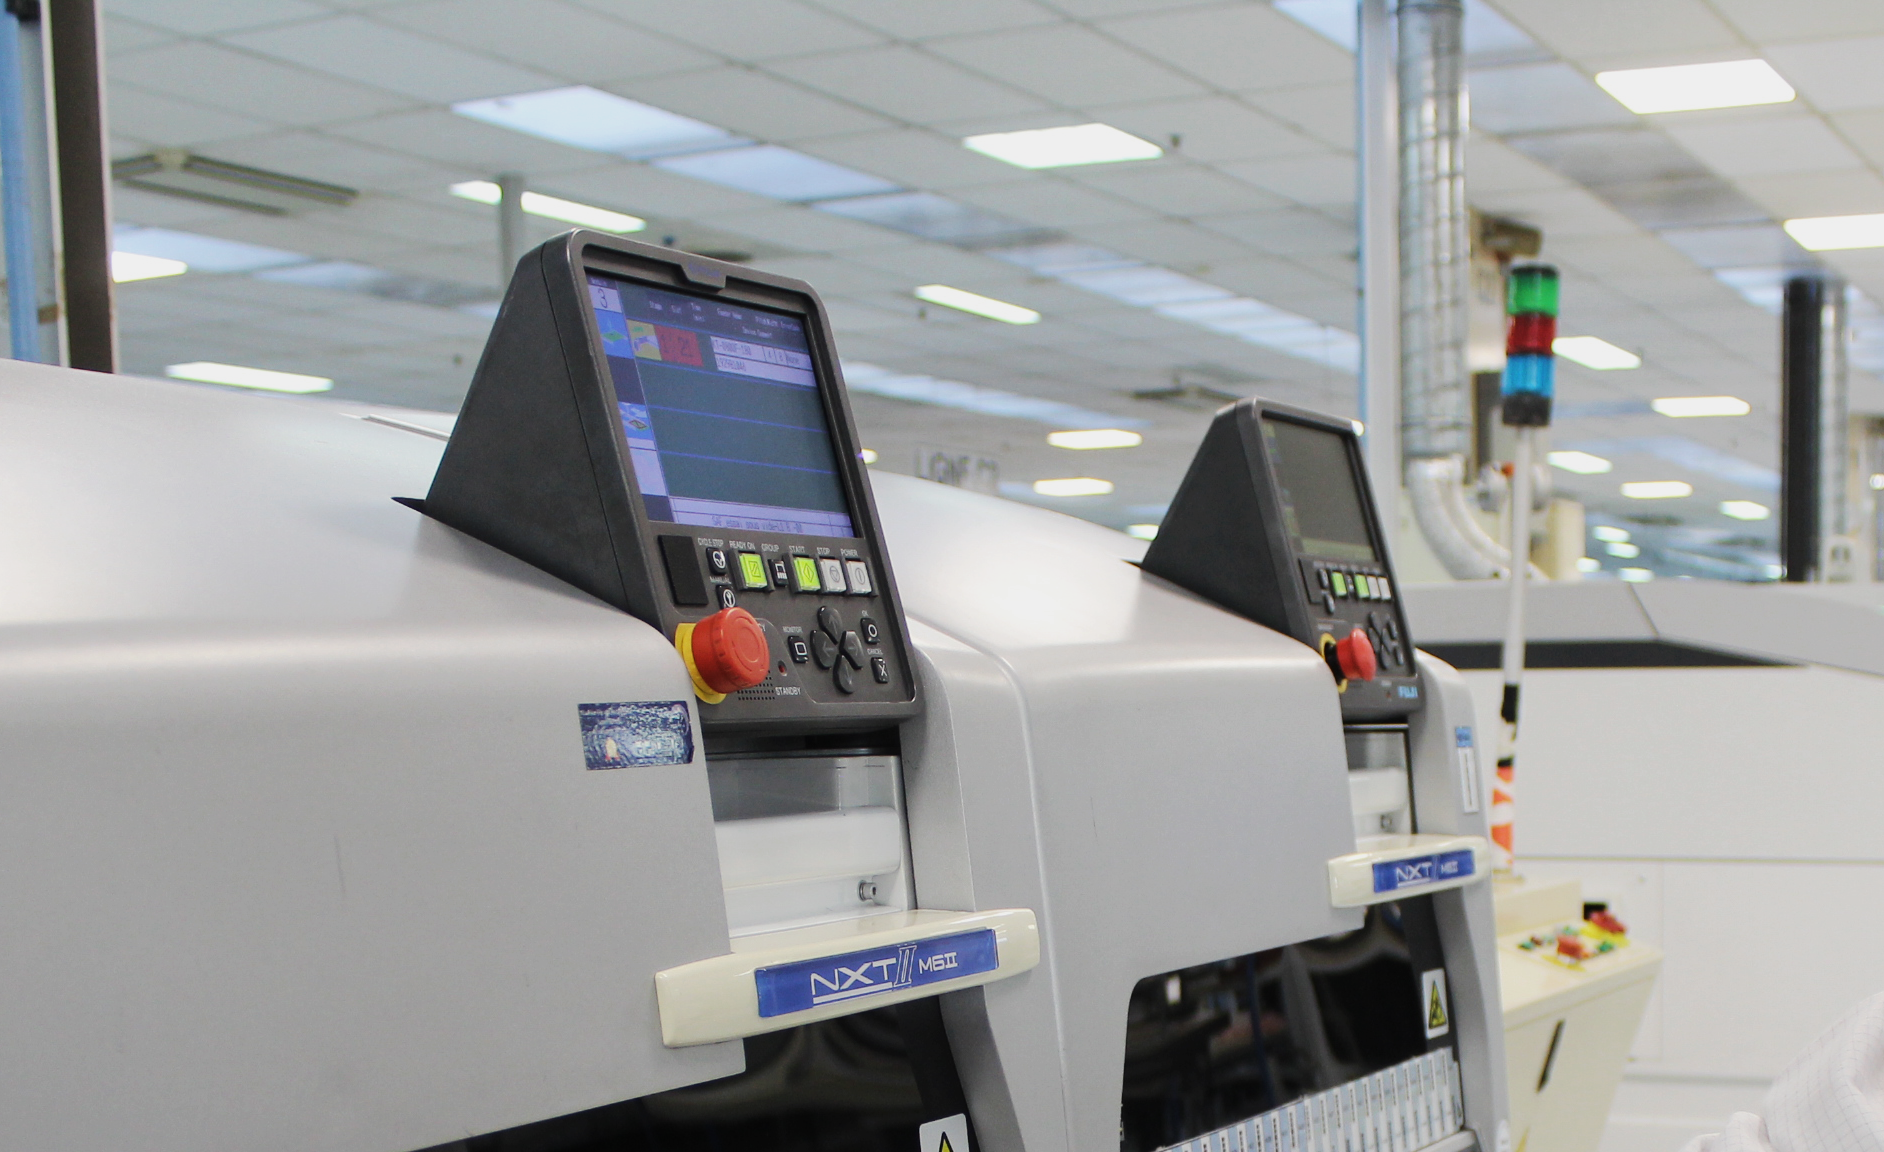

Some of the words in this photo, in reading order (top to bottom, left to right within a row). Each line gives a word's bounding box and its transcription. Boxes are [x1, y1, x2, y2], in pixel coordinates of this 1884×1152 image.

[598, 288, 608, 309] 3
[698, 538, 712, 547] CYCLE
[712, 539, 724, 547] STOP
[730, 540, 746, 550] READY
[748, 542, 756, 550] ON
[762, 542, 780, 553] GROUP
[788, 545, 805, 554] START
[816, 546, 830, 556] STOP
[840, 548, 858, 557] POWER
[776, 686, 800, 695] STANDBY
[1396, 861, 1432, 882] NXT
[810, 958, 896, 996] NXT
[918, 952, 958, 975] M6II
